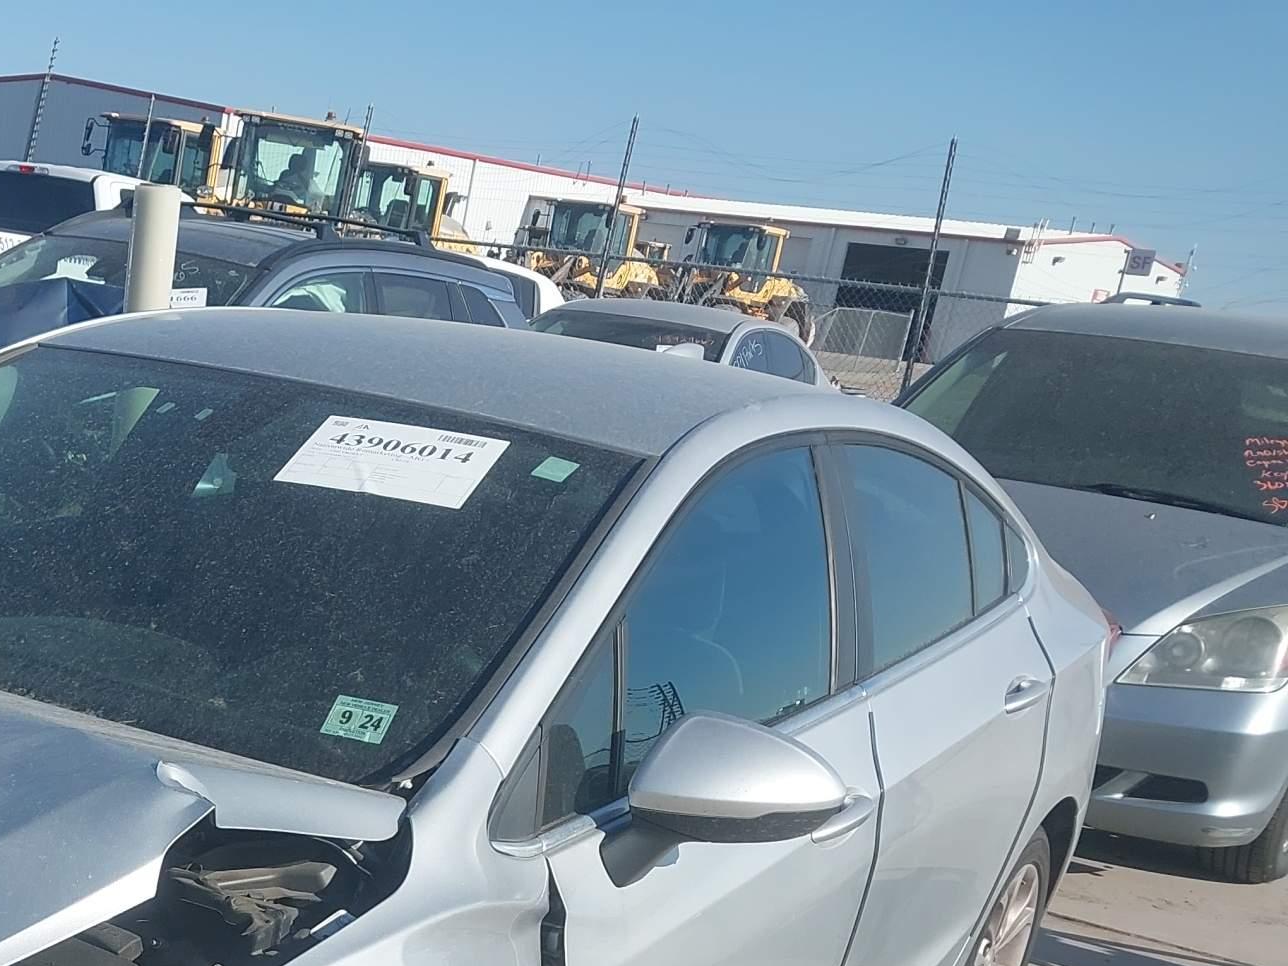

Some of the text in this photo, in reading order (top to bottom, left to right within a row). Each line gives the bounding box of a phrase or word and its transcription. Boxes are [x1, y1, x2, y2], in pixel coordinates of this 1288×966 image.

[1130, 255, 1153, 270] SF
[329, 432, 474, 464] 43906014
[339, 710, 384, 732] 9 24
